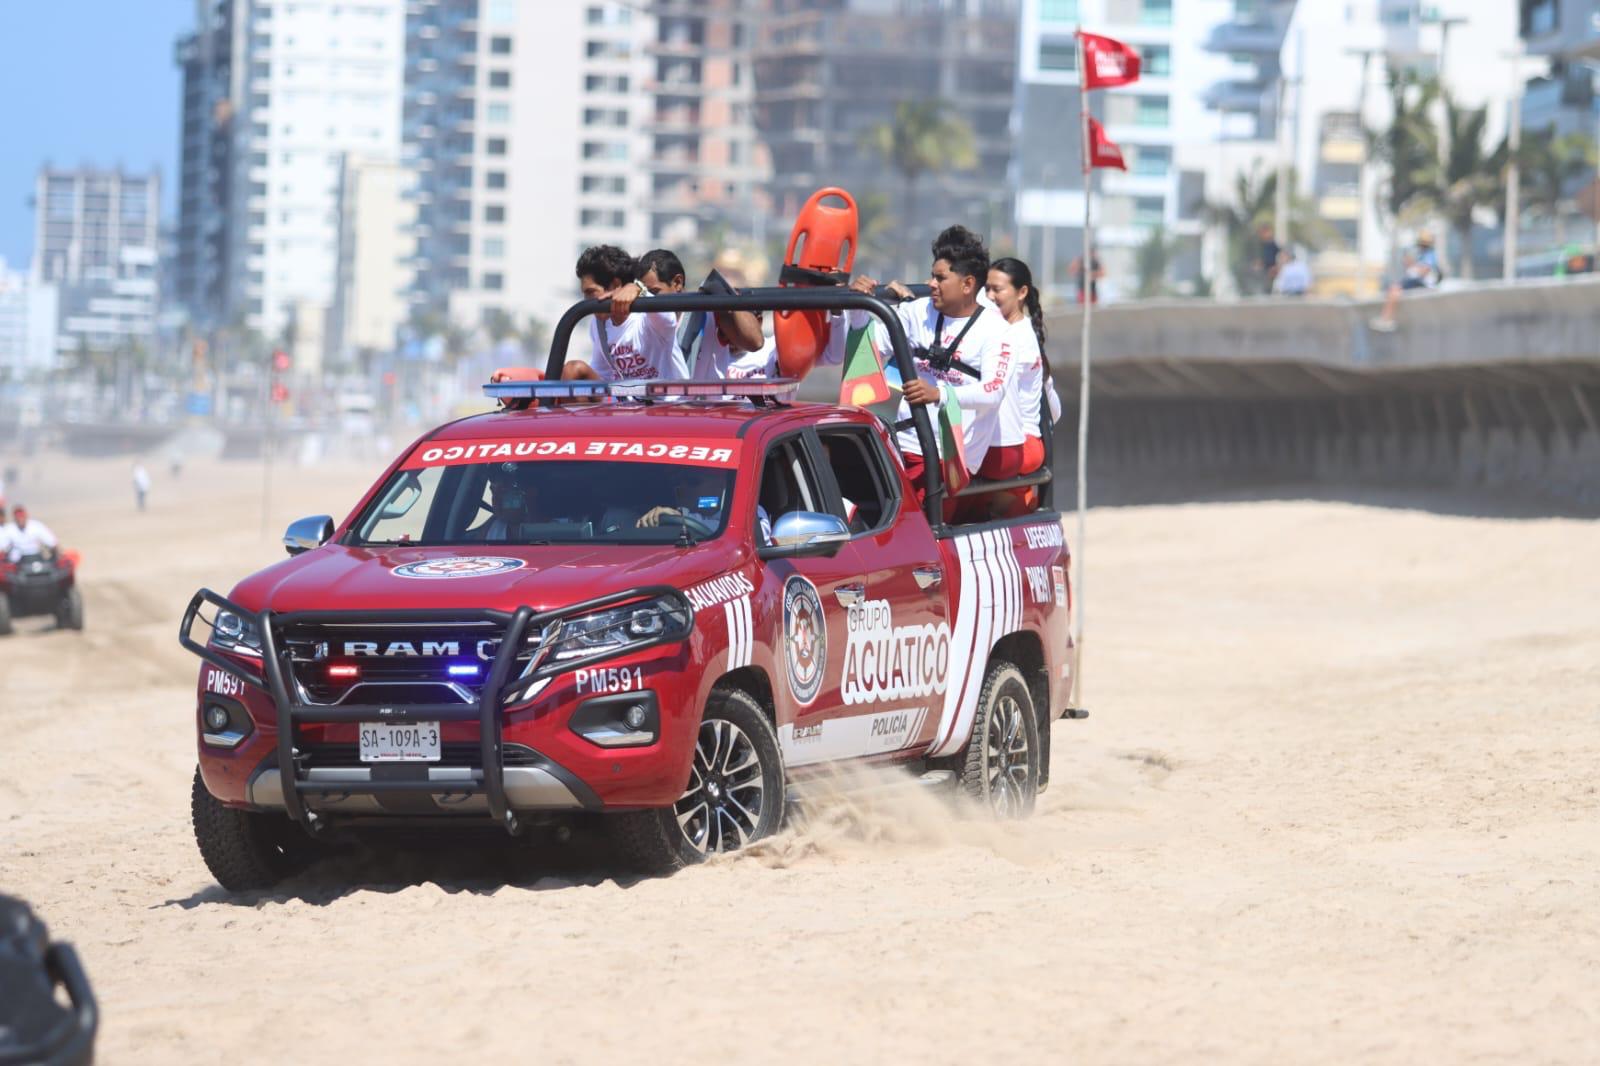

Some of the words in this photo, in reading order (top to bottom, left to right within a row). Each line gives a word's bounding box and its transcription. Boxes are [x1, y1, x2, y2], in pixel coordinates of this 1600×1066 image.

[611, 353, 646, 370] 026
[684, 570, 755, 612] SALVAVIDAS
[849, 606, 890, 632] GRUPO
[344, 641, 459, 656] RAM
[845, 632, 949, 694] ACUATICO
[207, 669, 245, 696] PM591
[575, 666, 643, 693] PM591
[362, 729, 438, 748] SA-109A-3
